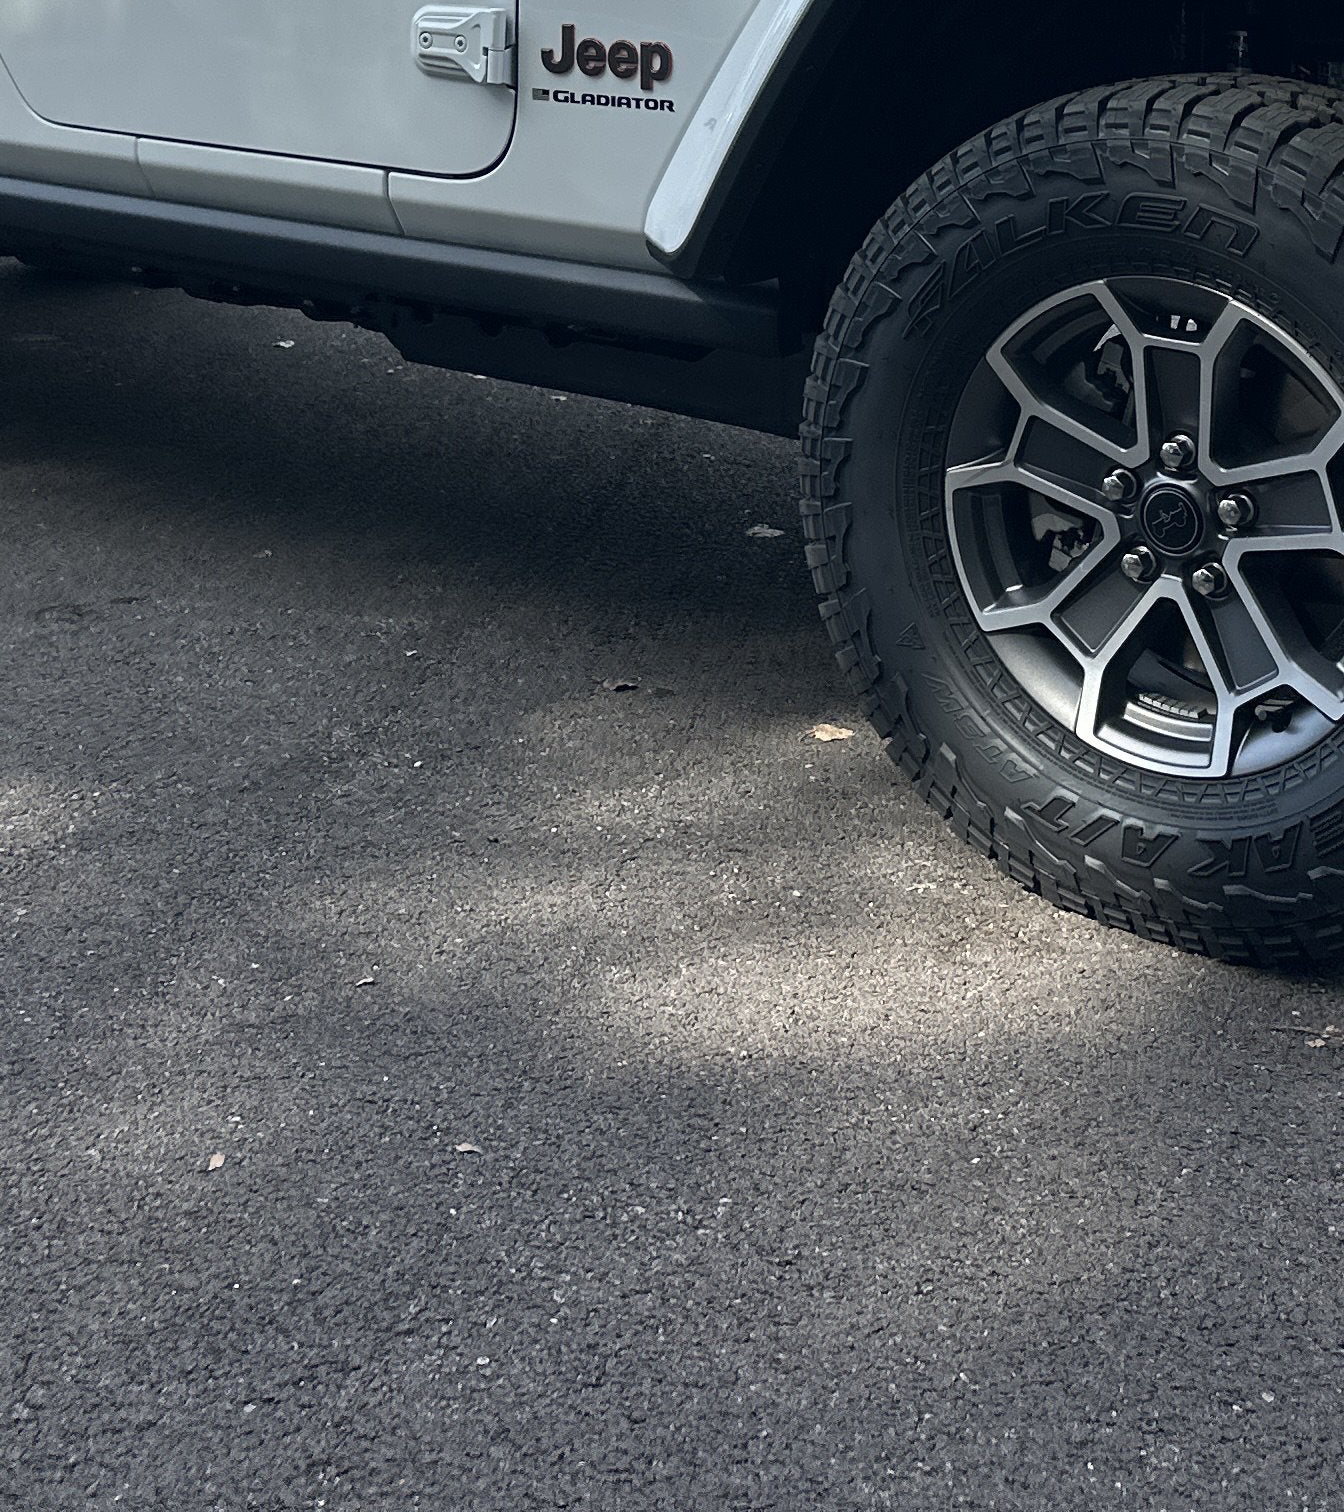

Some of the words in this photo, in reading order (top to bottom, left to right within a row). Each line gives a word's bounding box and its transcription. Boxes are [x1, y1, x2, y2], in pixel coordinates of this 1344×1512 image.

[541, 24, 674, 90] Jeep
[553, 89, 676, 112] GLADIATOR
[901, 190, 1260, 339] FALKEN
